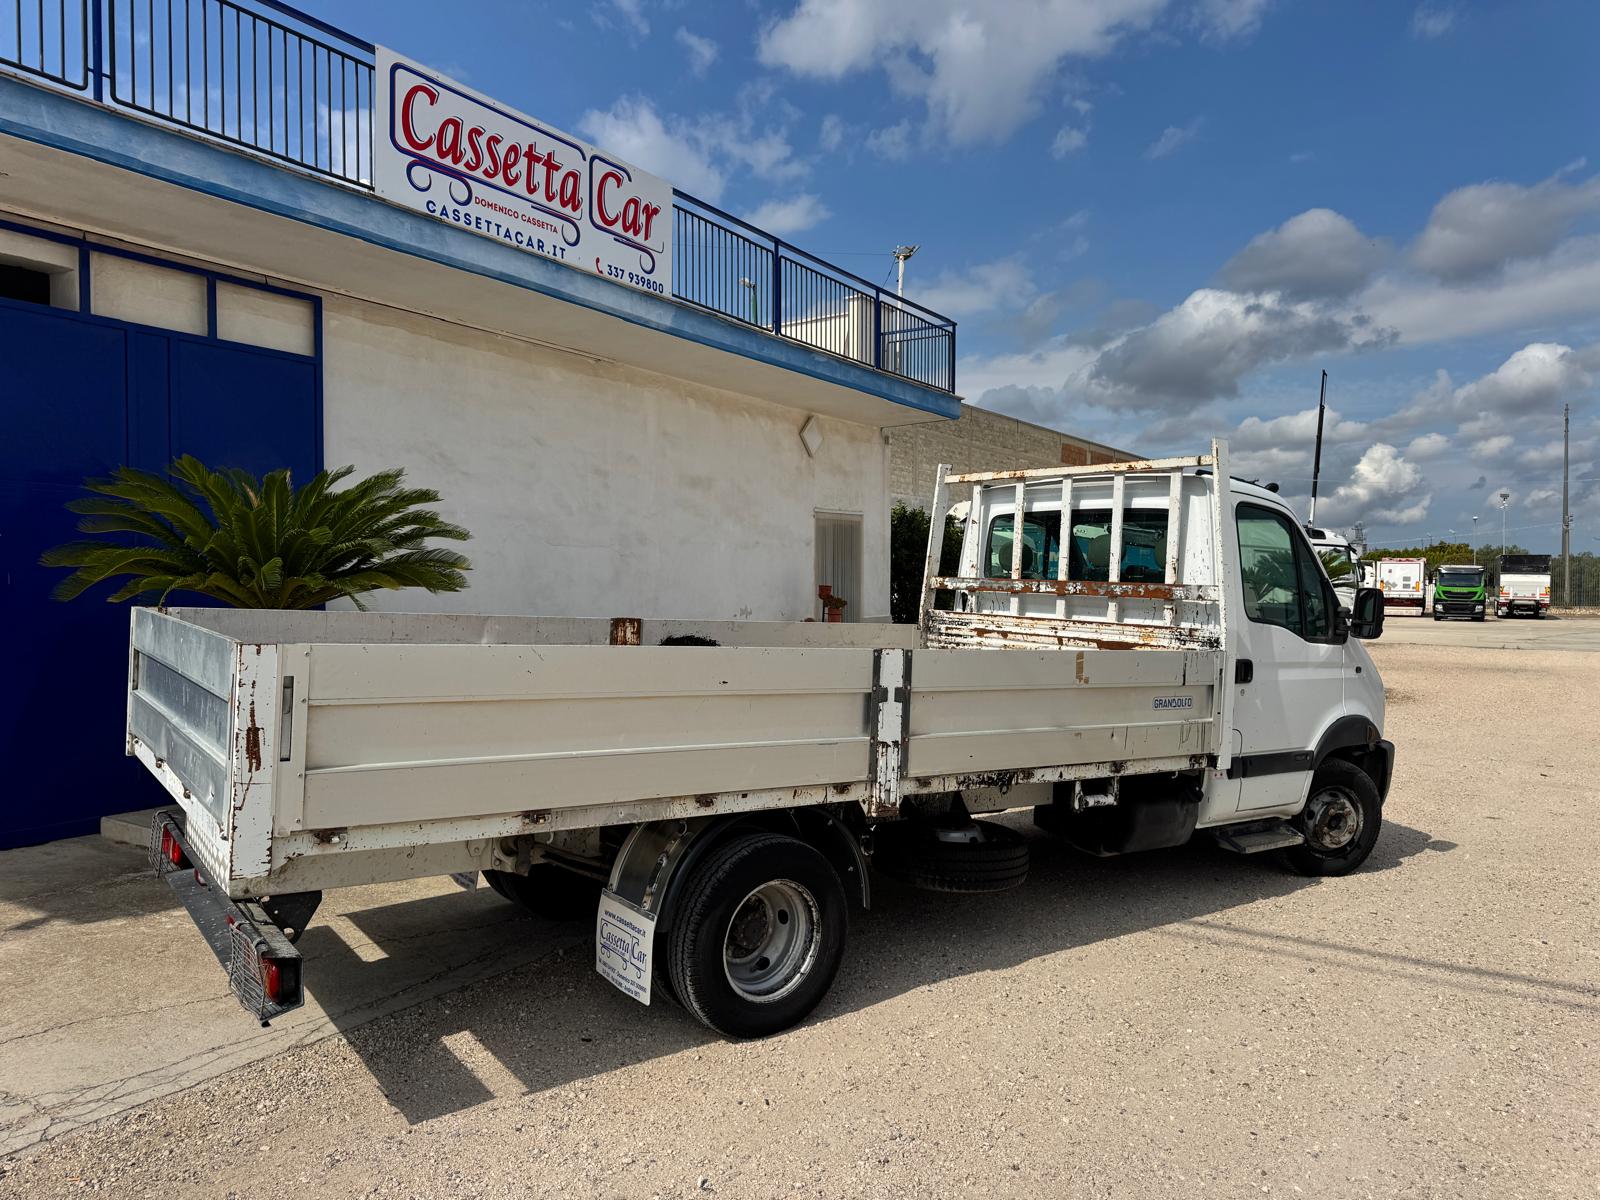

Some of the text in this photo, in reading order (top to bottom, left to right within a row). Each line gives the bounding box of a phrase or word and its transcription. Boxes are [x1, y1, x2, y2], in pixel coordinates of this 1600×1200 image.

[402, 83, 662, 241] Cassetta Car
[426, 200, 566, 259] CASSETTACAR.IT
[474, 196, 558, 234] DOMENICO CASSETTA
[607, 264, 664, 294] 337 939800
[601, 922, 630, 954] Cassetta
[632, 941, 648, 963] Car
